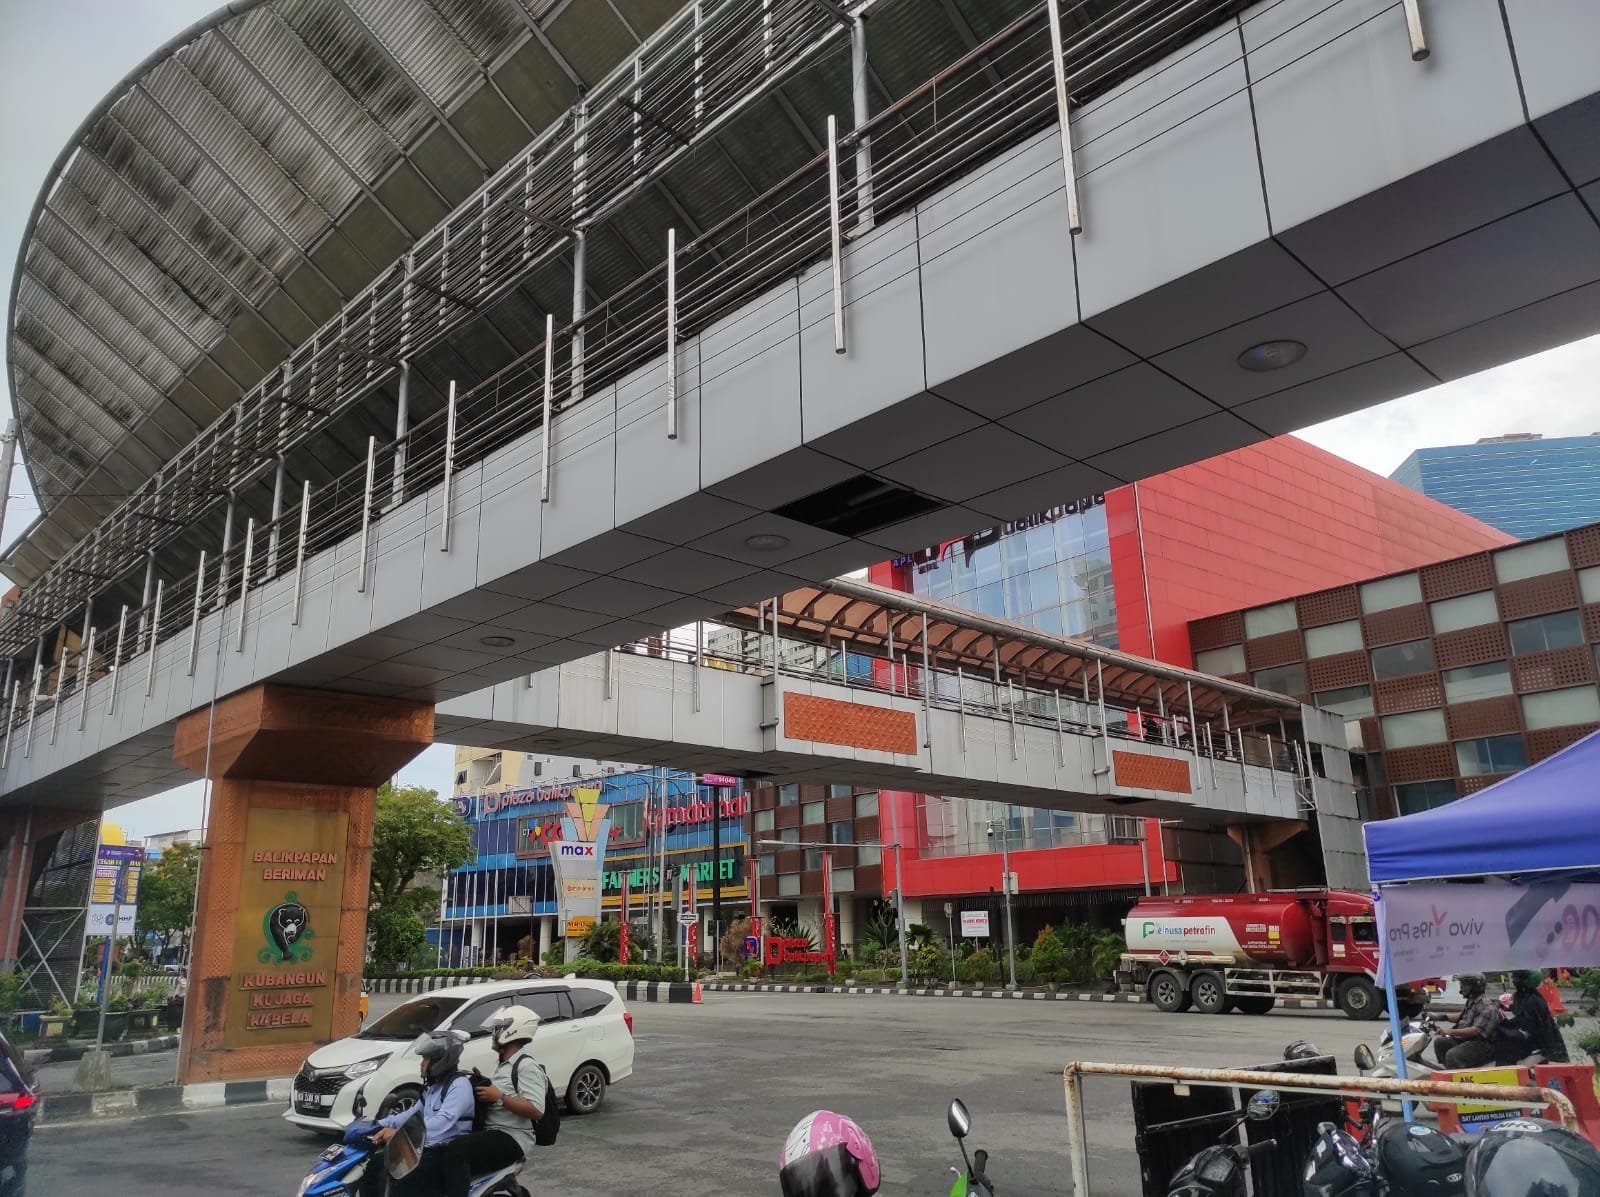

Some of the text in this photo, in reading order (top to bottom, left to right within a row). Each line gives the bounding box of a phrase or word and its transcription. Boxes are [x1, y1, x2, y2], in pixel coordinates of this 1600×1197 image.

[501, 780, 603, 809] plaza balikpn
[253, 850, 337, 864] BALIKPAPAN
[561, 845, 593, 856] max
[263, 868, 326, 881] BERIMAN
[680, 858, 736, 883] MARET
[1183, 925, 1216, 936] petrofin
[242, 971, 326, 988] KUBANGUN
